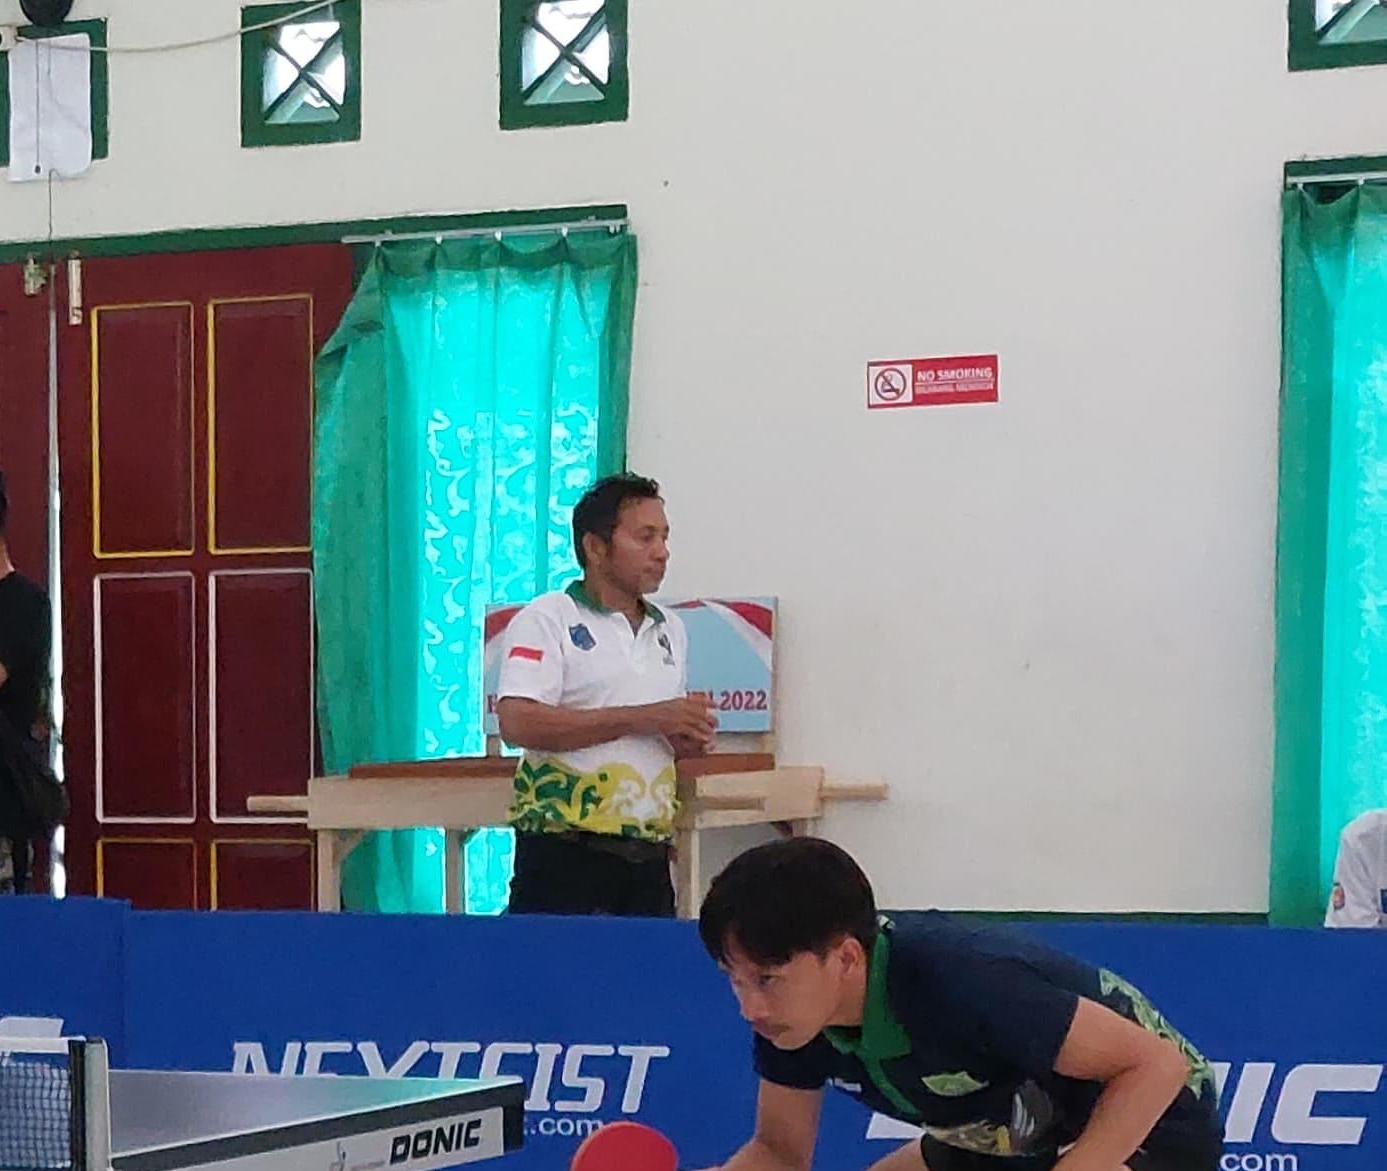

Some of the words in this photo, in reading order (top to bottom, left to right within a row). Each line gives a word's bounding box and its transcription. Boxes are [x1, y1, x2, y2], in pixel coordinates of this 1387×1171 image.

[917, 369, 936, 381] NO
[936, 366, 993, 381] SMOKING
[719, 689, 768, 712] 2022
[389, 1118, 483, 1166] DONIC
